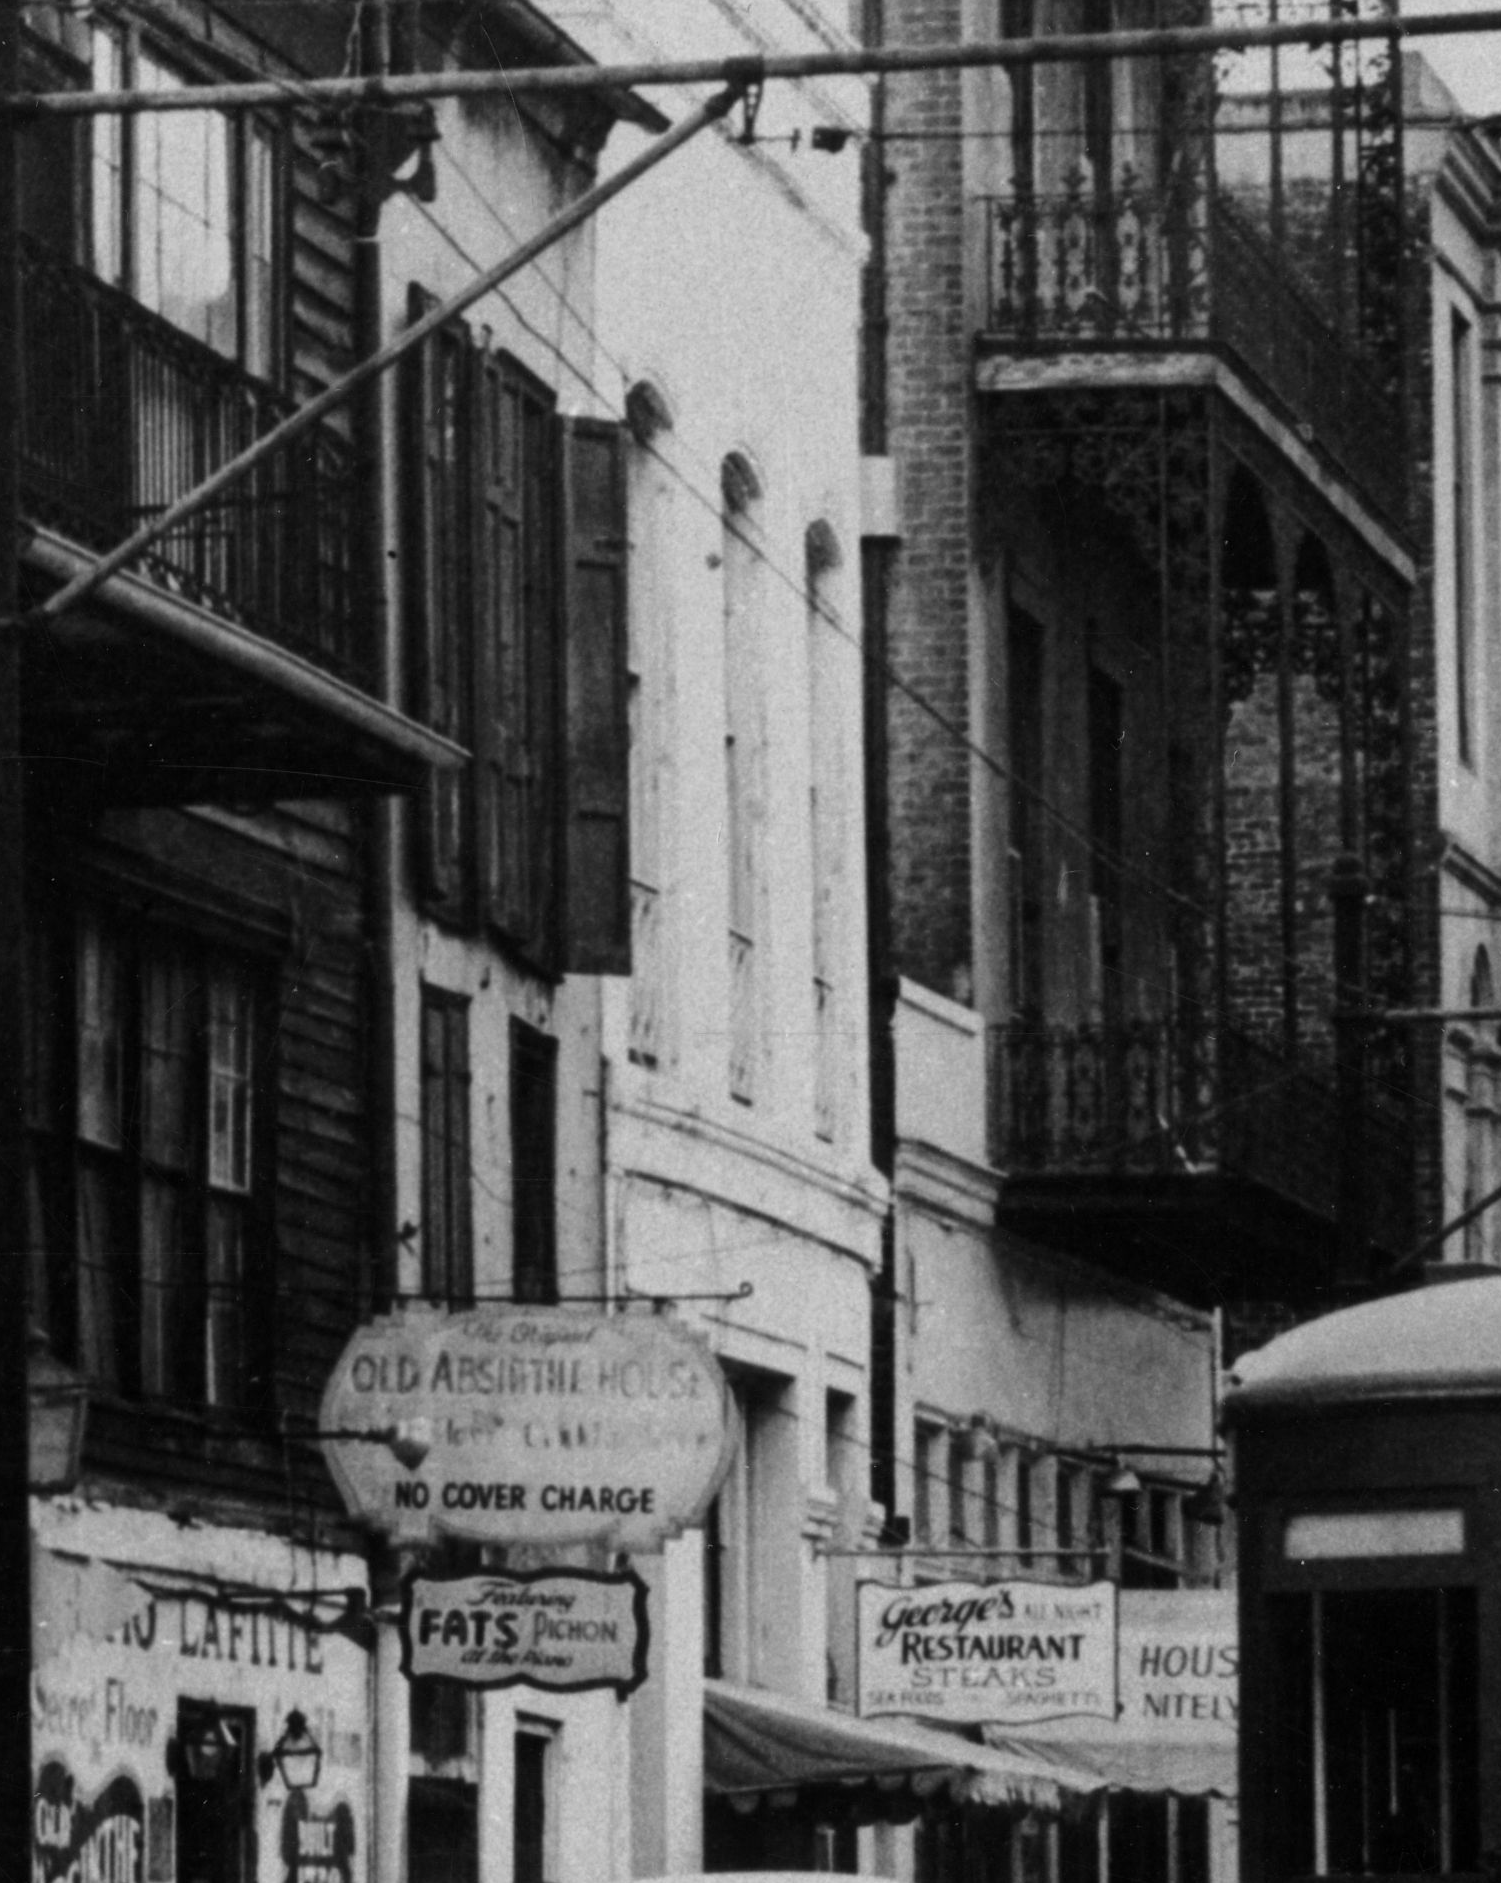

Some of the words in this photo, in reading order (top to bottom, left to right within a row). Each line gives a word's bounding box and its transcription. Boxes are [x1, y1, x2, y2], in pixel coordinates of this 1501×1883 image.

[350, 1353, 421, 1395] OLD
[430, 1349, 582, 1395] ABSINTHE
[394, 1480, 431, 1511] NO
[441, 1481, 528, 1512] COVER
[539, 1484, 656, 1515] CHARGE
[465, 1579, 577, 1615] Featuring
[418, 1608, 520, 1650] FATS
[533, 1610, 618, 1647] PICHON
[874, 1588, 1015, 1649] George's
[901, 1630, 1086, 1666] RESTAURANT
[1139, 1644, 1240, 1679] HOUS
[909, 1666, 1057, 1688] STEAKS
